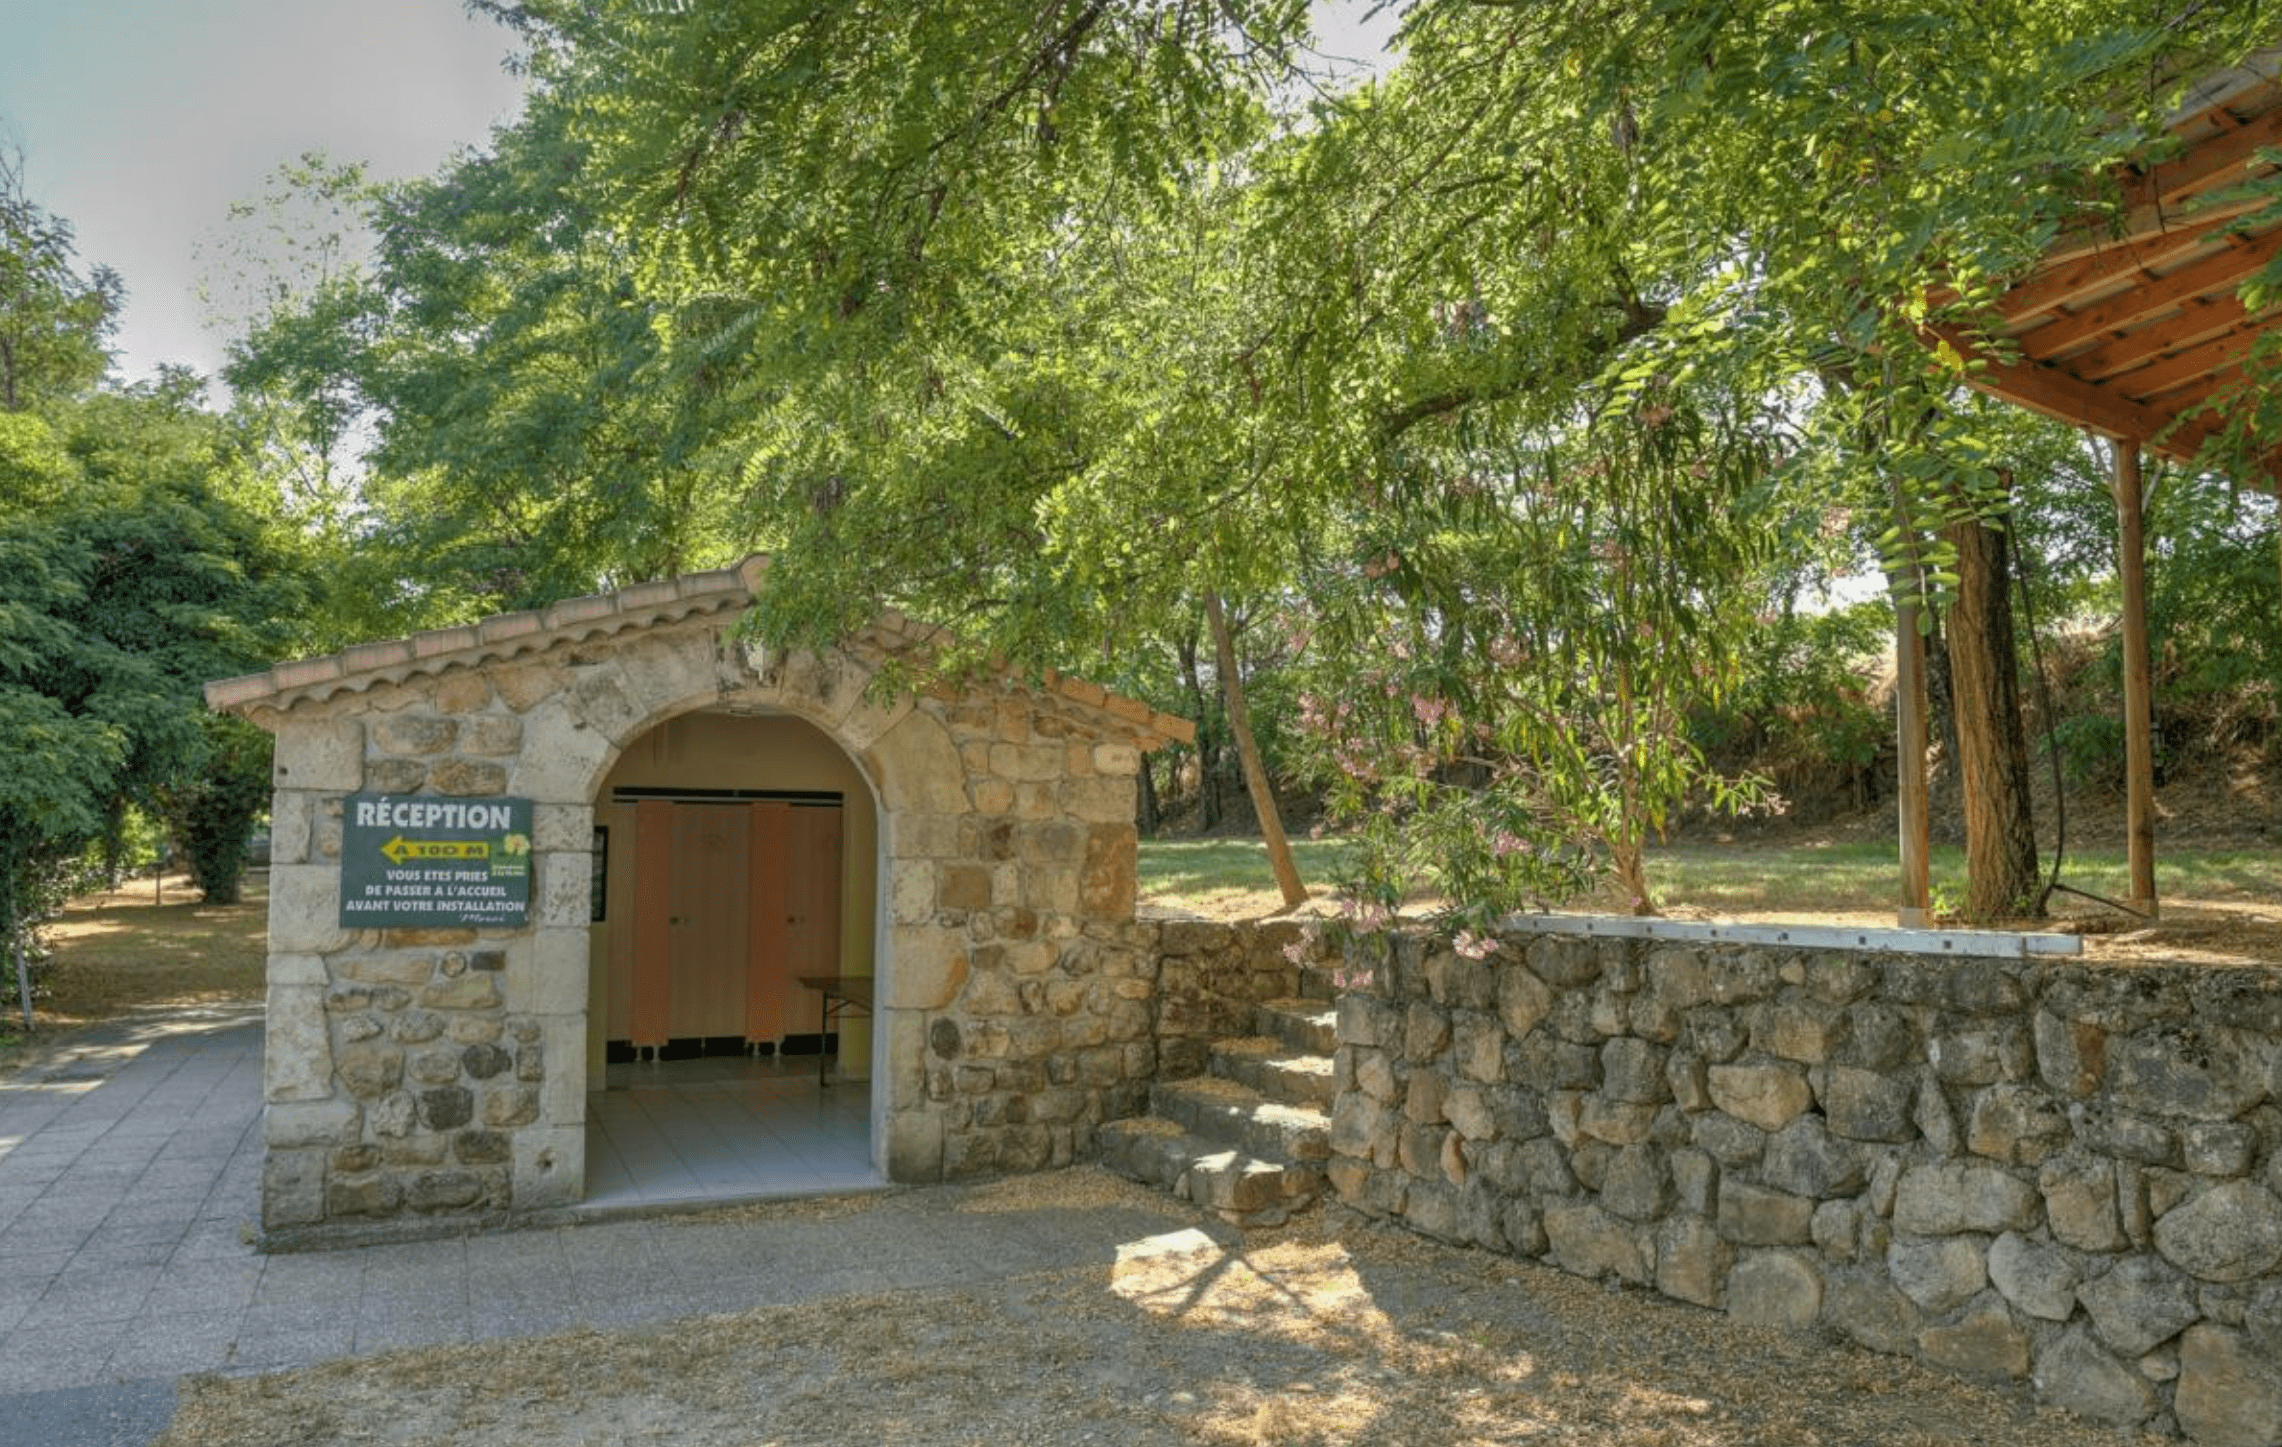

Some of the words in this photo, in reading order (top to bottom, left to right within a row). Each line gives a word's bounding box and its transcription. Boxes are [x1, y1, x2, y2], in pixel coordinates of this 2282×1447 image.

[356, 796, 511, 830] RÉCEPTION
[418, 844, 458, 855] 100
[463, 844, 486, 855] M
[387, 870, 420, 881] VOUS
[424, 871, 451, 881] ETES
[455, 871, 488, 882] PRIES
[366, 885, 382, 896] DE
[386, 885, 431, 896] PASSER
[434, 886, 444, 896] A
[447, 886, 507, 897] L'ACCUEIL
[346, 901, 390, 911] AVANT
[394, 901, 433, 911] VOTRE
[437, 901, 525, 912] INSTALLATION
